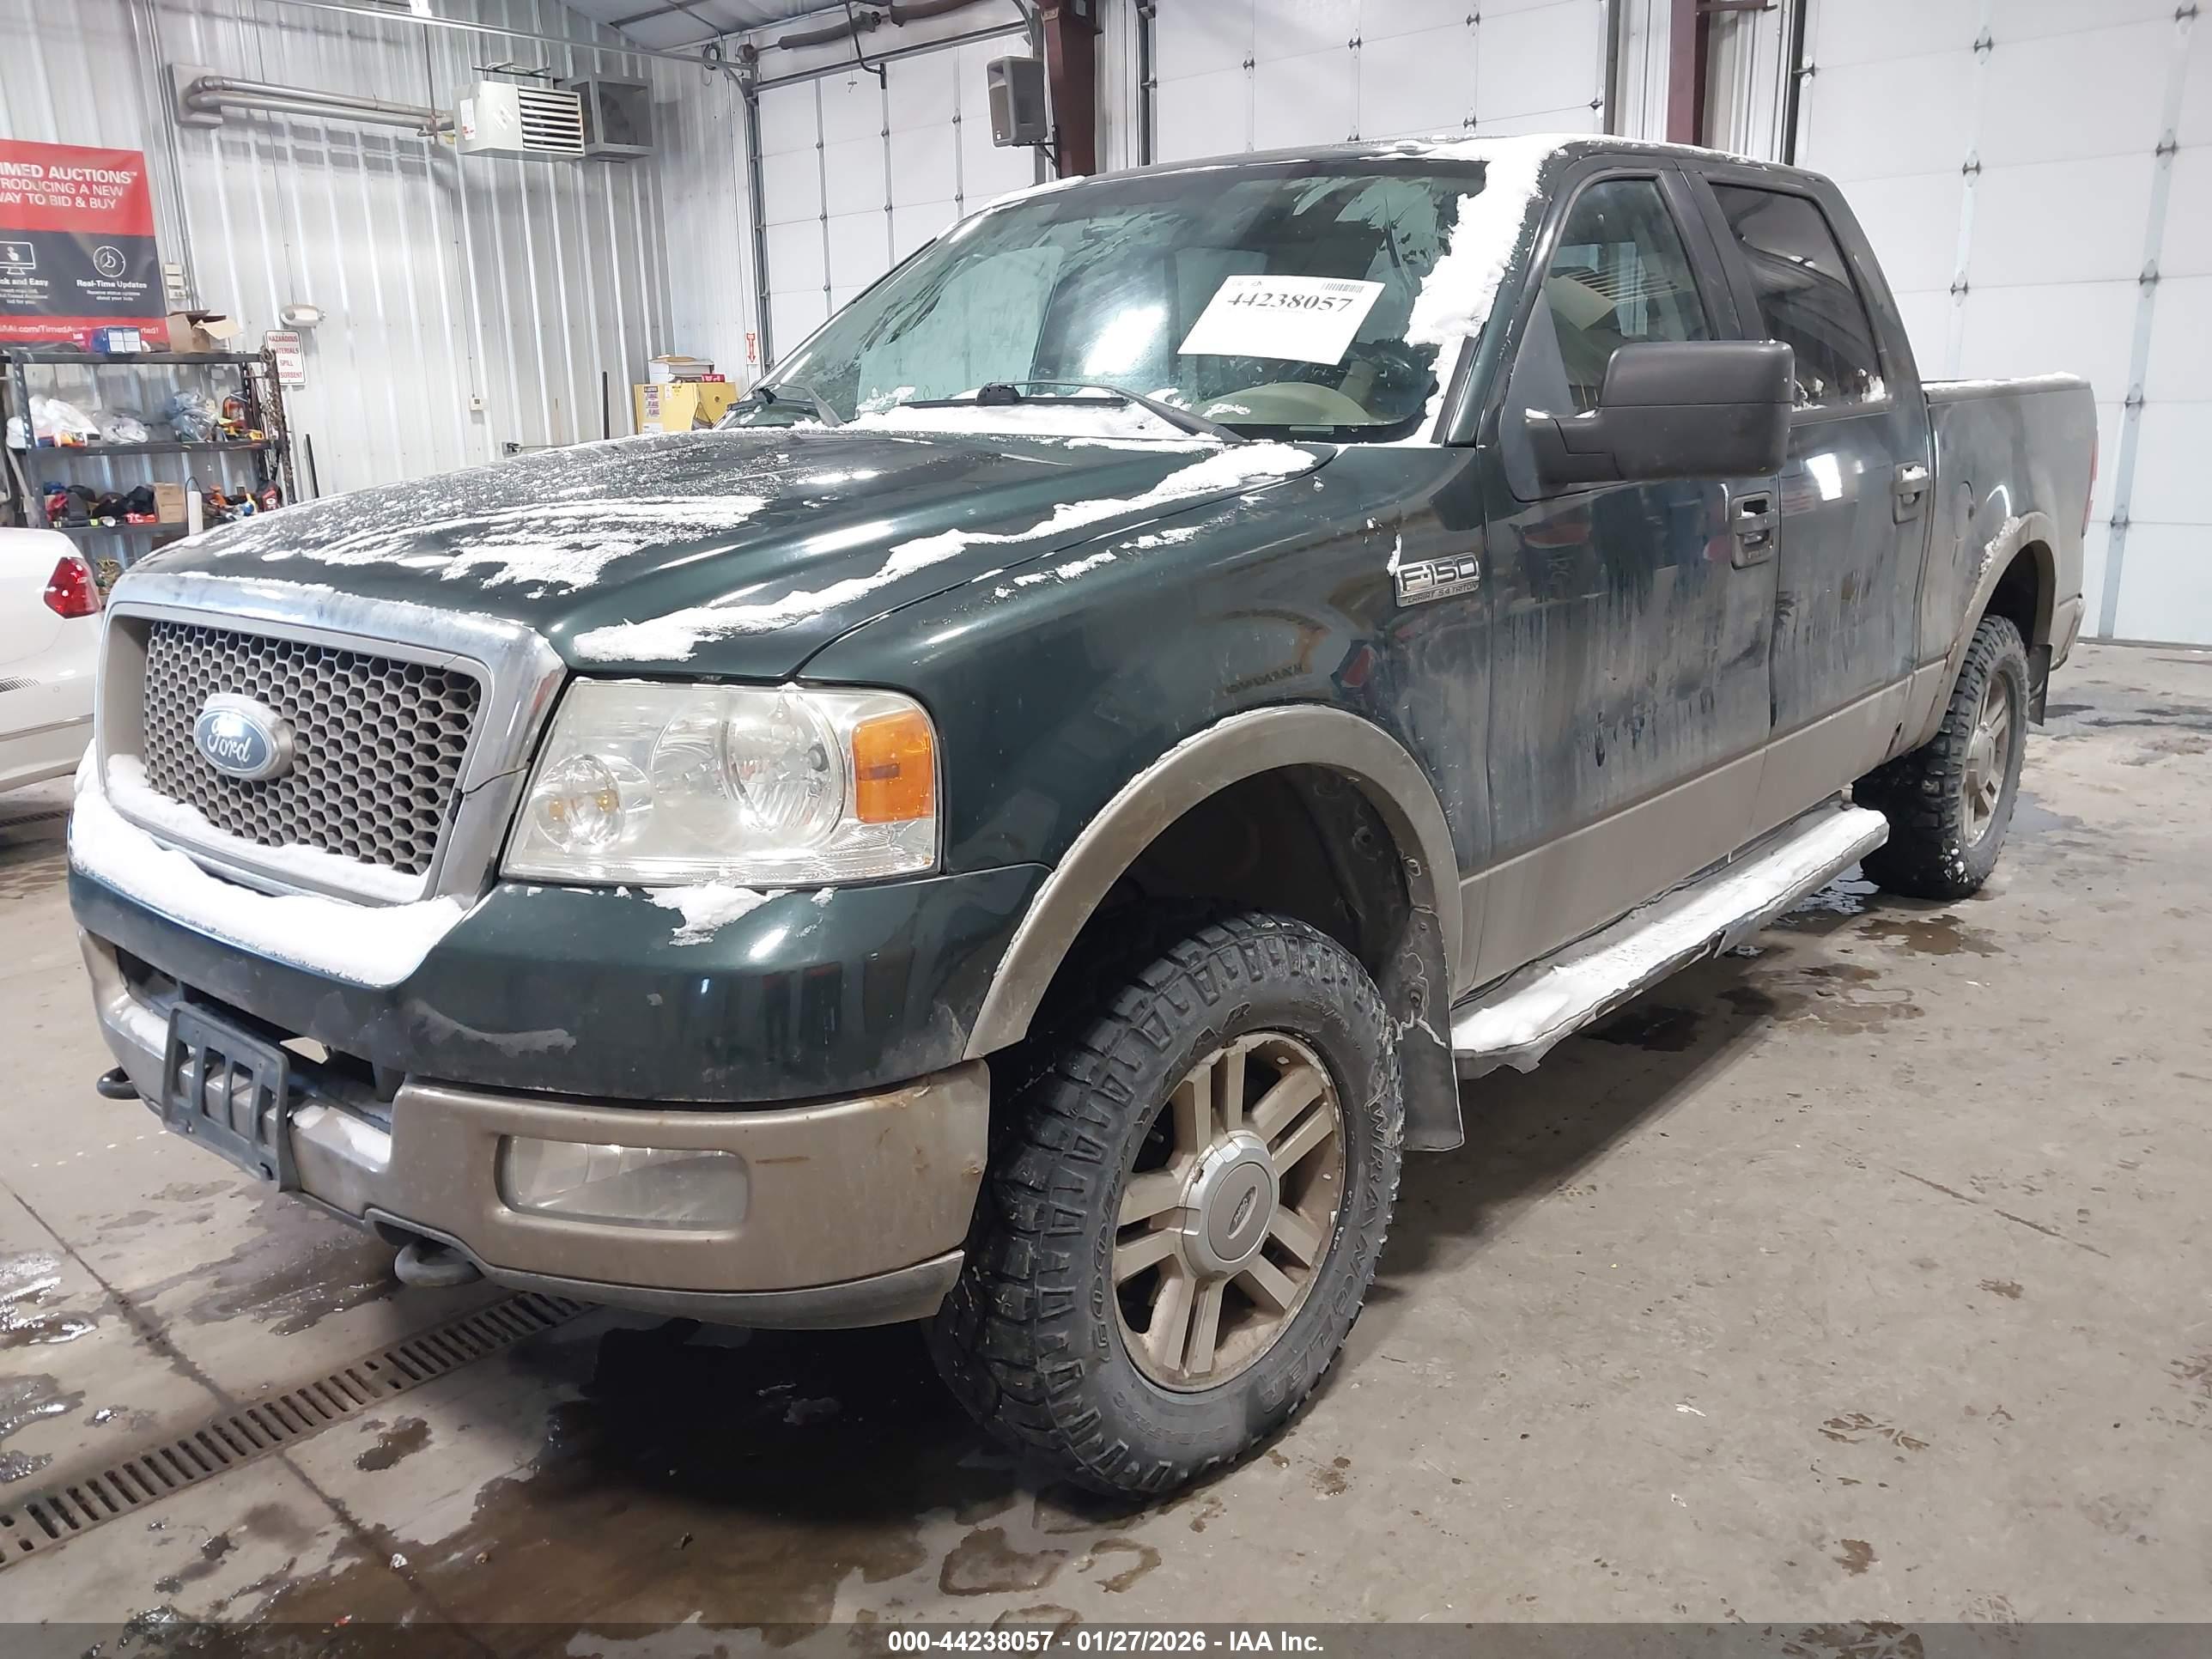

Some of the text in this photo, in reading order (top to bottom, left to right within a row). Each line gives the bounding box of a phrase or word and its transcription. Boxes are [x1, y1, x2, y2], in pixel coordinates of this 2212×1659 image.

[0, 161, 44, 178] IMED
[0, 177, 123, 197] RODUCING A NEW
[25, 192, 46, 205] TO
[50, 195, 71, 207] BID
[75, 196, 86, 208] &
[89, 198, 117, 209] BUY
[29, 277, 48, 287] Easy
[76, 279, 148, 289] Real-Time Updates
[1227, 292, 1354, 313] 44238057
[206, 711, 252, 763] Ford
